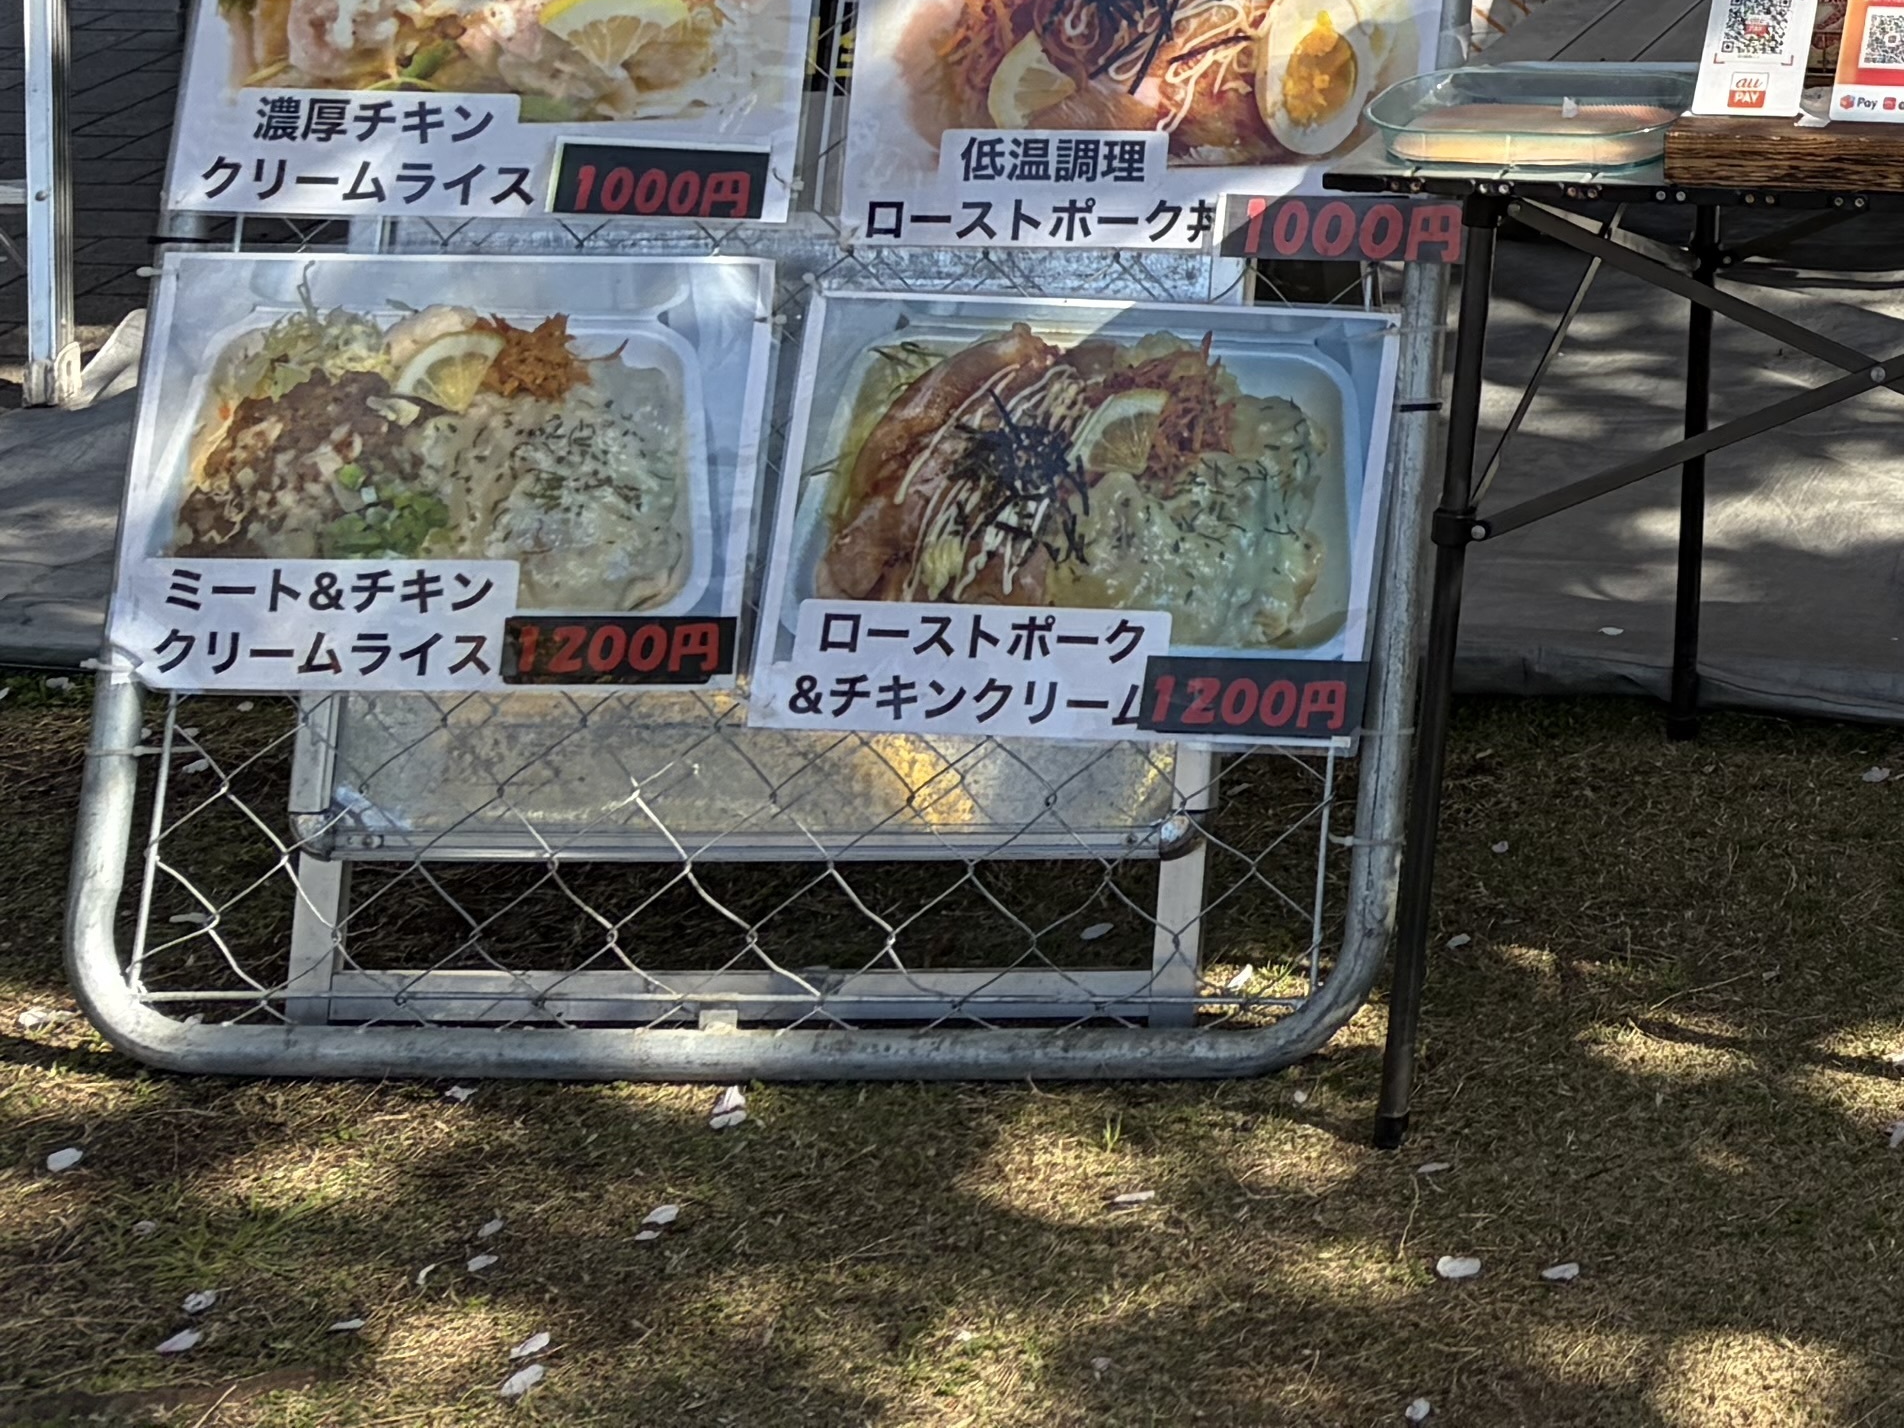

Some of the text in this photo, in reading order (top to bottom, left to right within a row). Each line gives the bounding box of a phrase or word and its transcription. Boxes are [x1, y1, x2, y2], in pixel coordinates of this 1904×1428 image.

[255, 98, 495, 144] 濃厚チキン
[1734, 92, 1760, 104] PAY
[1856, 97, 1878, 110] Pay
[202, 155, 536, 207] クリームライス
[960, 136, 1147, 185] 低温調理
[571, 158, 751, 216] 1000円
[1239, 200, 1462, 262] 1000円
[169, 567, 495, 616] ミート&チキン
[152, 629, 491, 678] クリームライス
[512, 620, 722, 678] 1200円
[820, 614, 1144, 660] ローストポーク
[788, 673, 1145, 727] &チキンクリーム
[1151, 678, 1347, 731] 1200円
